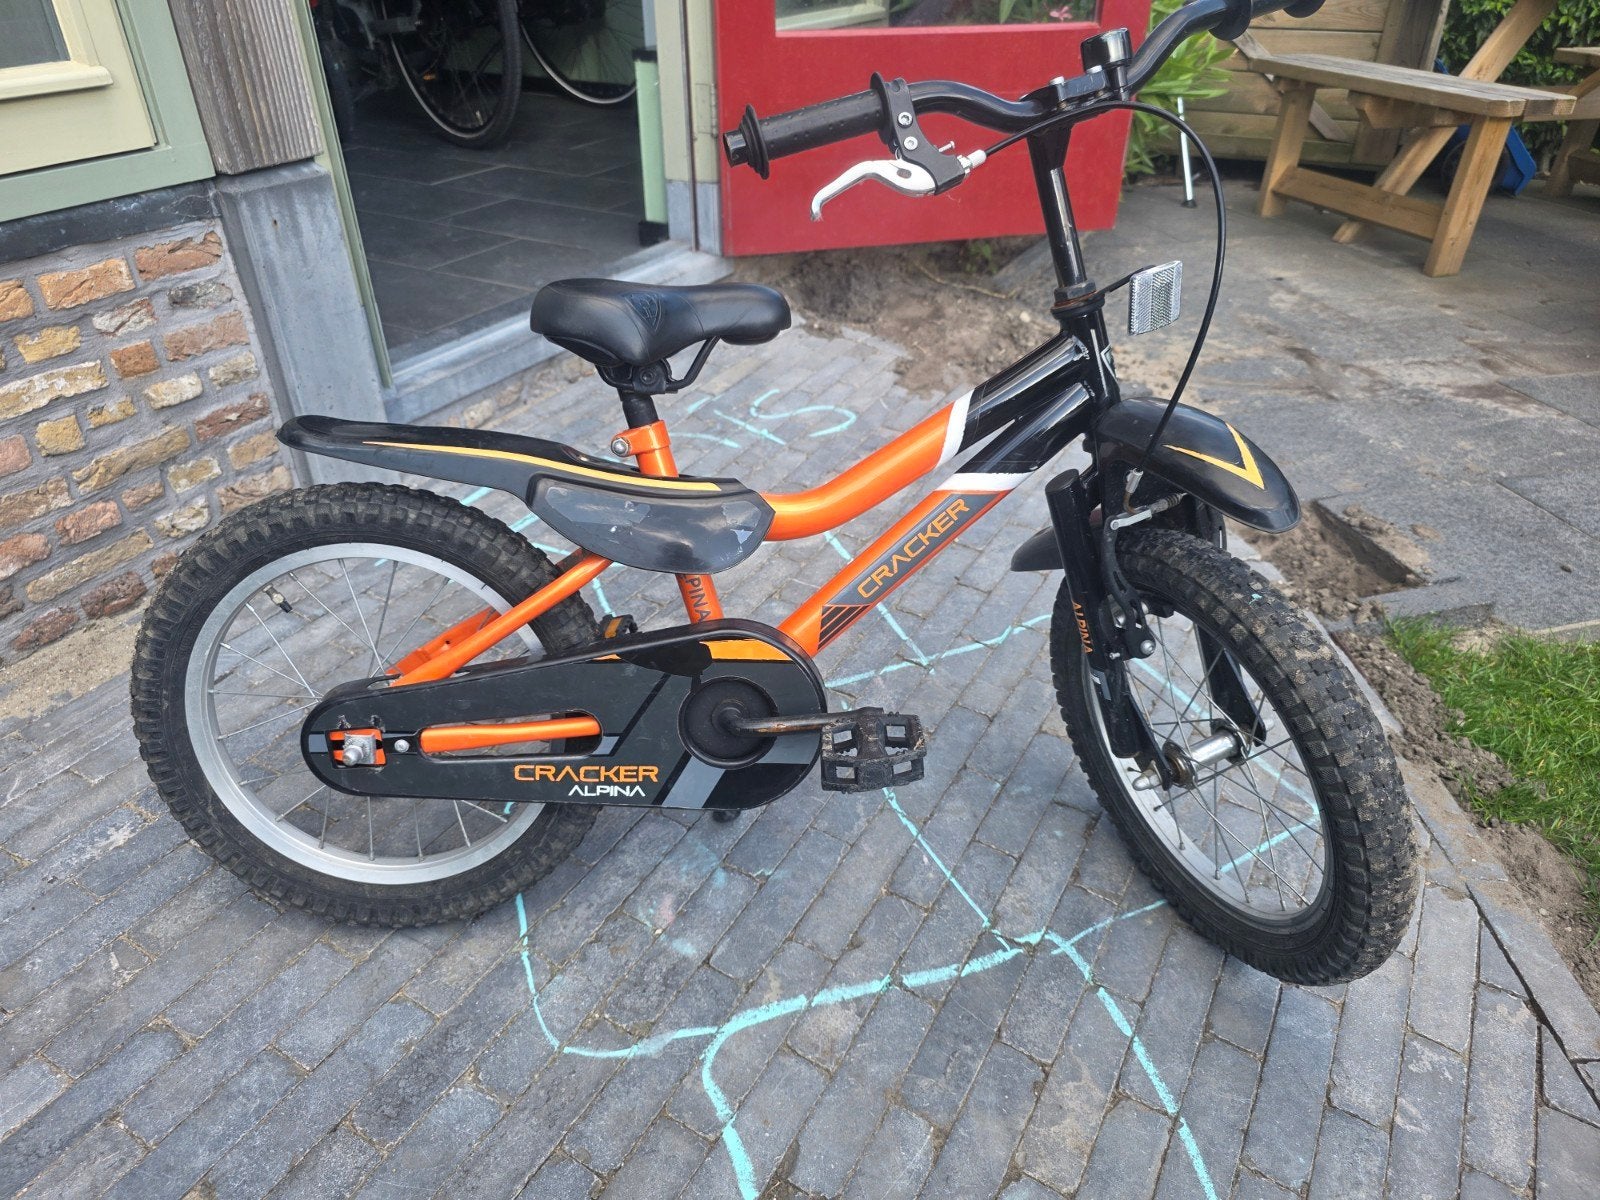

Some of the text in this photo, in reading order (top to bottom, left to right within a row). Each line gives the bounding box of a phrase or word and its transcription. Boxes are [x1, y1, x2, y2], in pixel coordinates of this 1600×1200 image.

[857, 498, 970, 598] CRACKER
[681, 574, 712, 622] PINA
[514, 764, 659, 783] CRACKER
[568, 784, 646, 797] ALPINA
